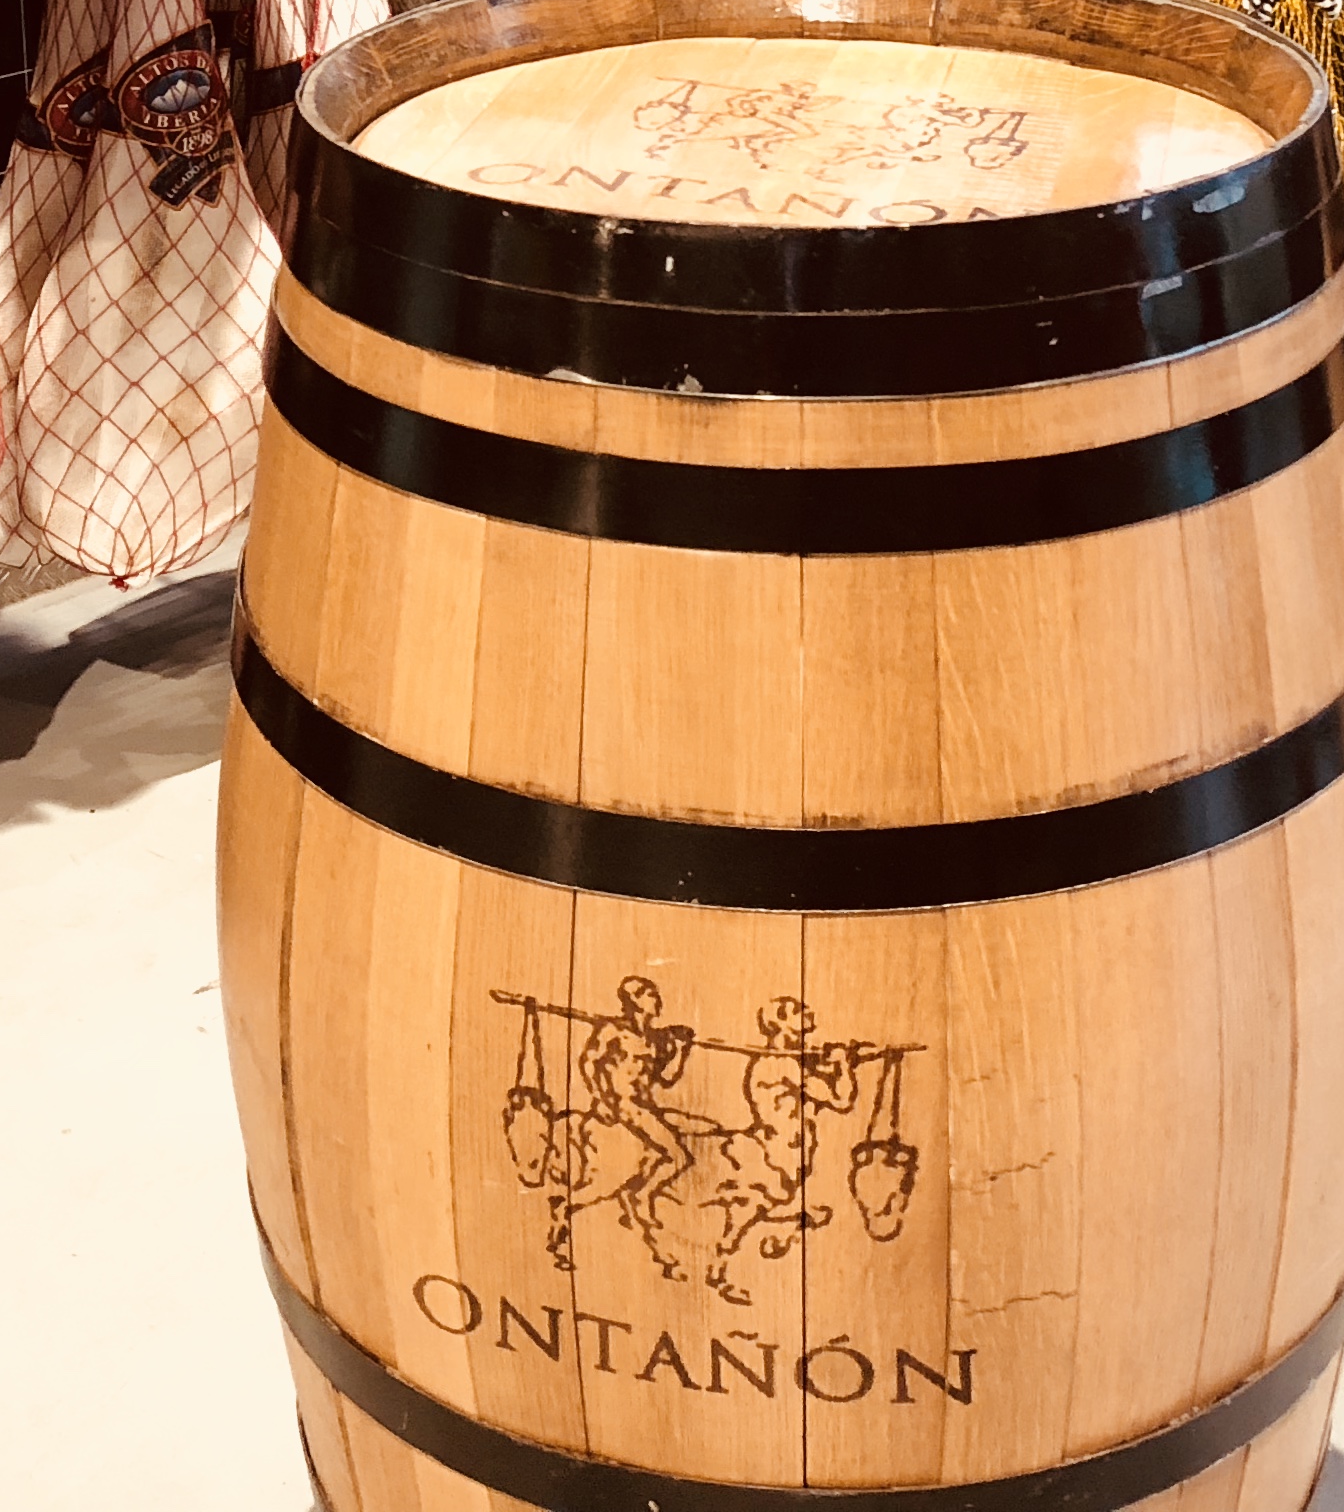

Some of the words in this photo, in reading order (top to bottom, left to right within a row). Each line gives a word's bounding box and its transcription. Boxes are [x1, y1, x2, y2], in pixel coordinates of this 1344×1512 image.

[56, 72, 103, 115] ALTO
[130, 54, 191, 98] ALTOS
[411, 1272, 980, 1406] ONTAÑÓN
